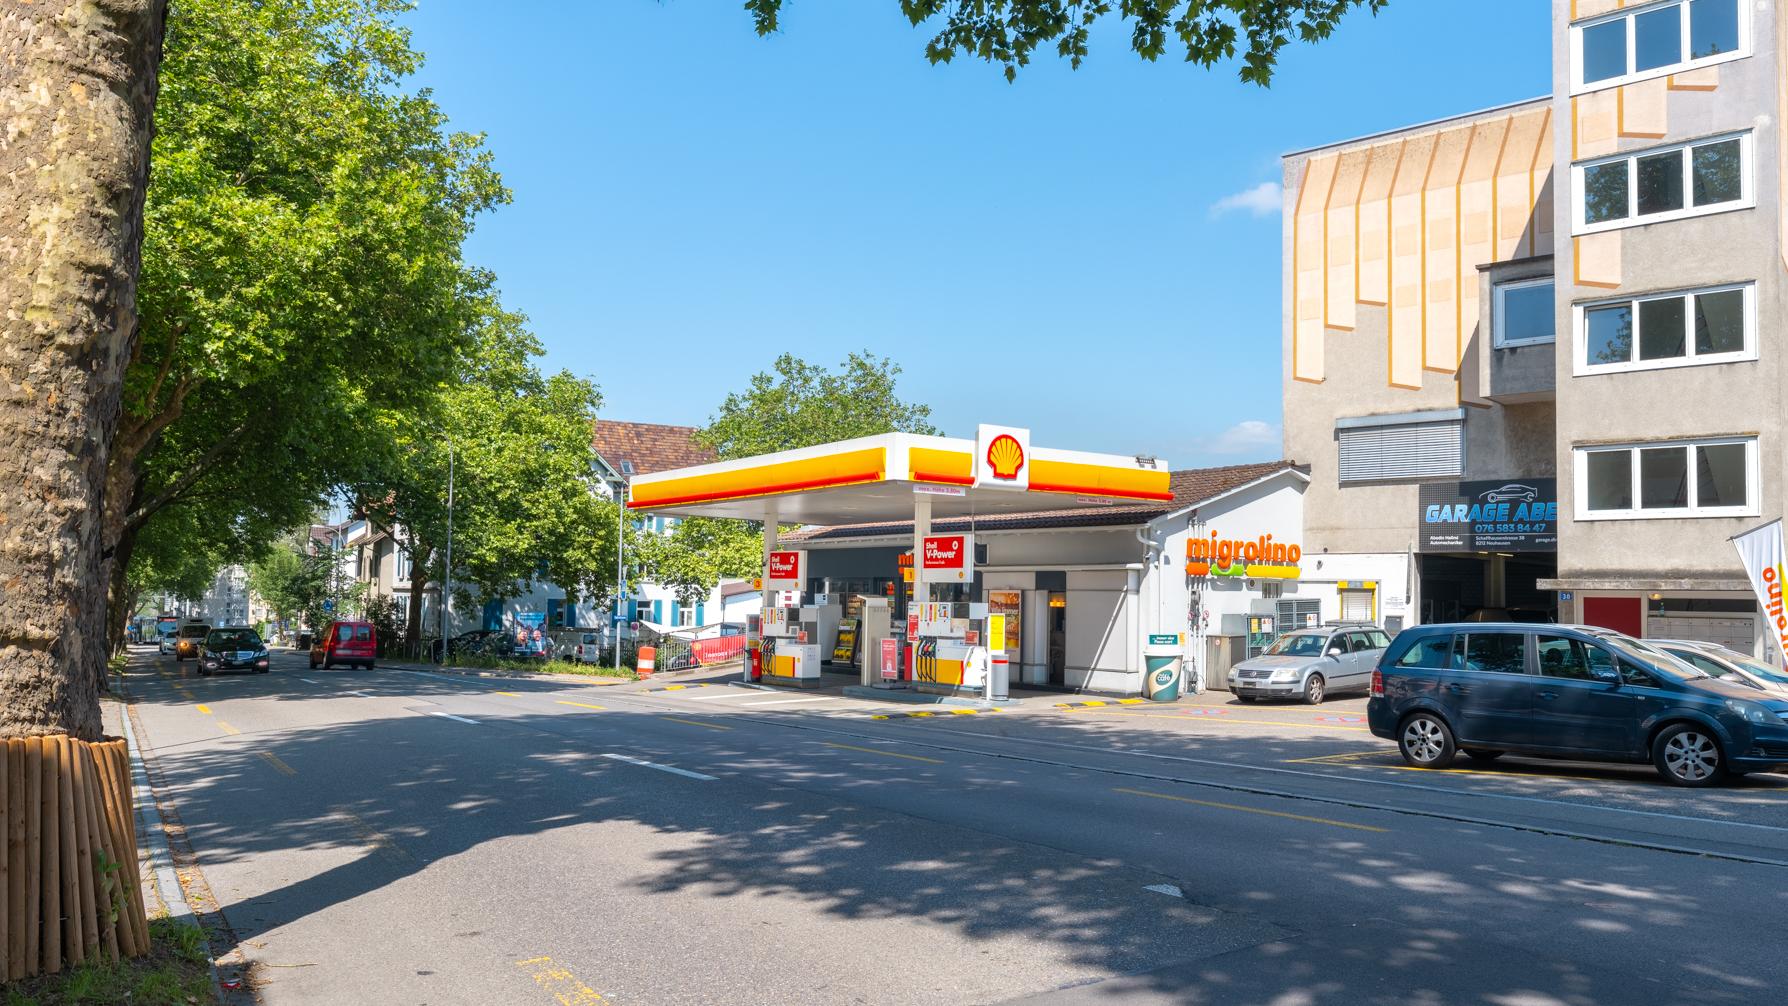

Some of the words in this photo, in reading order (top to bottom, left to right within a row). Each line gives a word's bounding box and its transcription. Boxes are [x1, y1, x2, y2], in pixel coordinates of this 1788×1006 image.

[1425, 504, 1510, 522] GARAGE
[1513, 502, 1557, 521] ABE
[1475, 523, 1494, 532] 076
[1496, 523, 1515, 532] 583
[1517, 523, 1531, 532] 84
[1532, 523, 1546, 532] 47
[926, 541, 938, 549] Shell
[1186, 530, 1301, 569] migrolino
[926, 549, 956, 559] V-Power
[771, 562, 793, 571] V-Power
